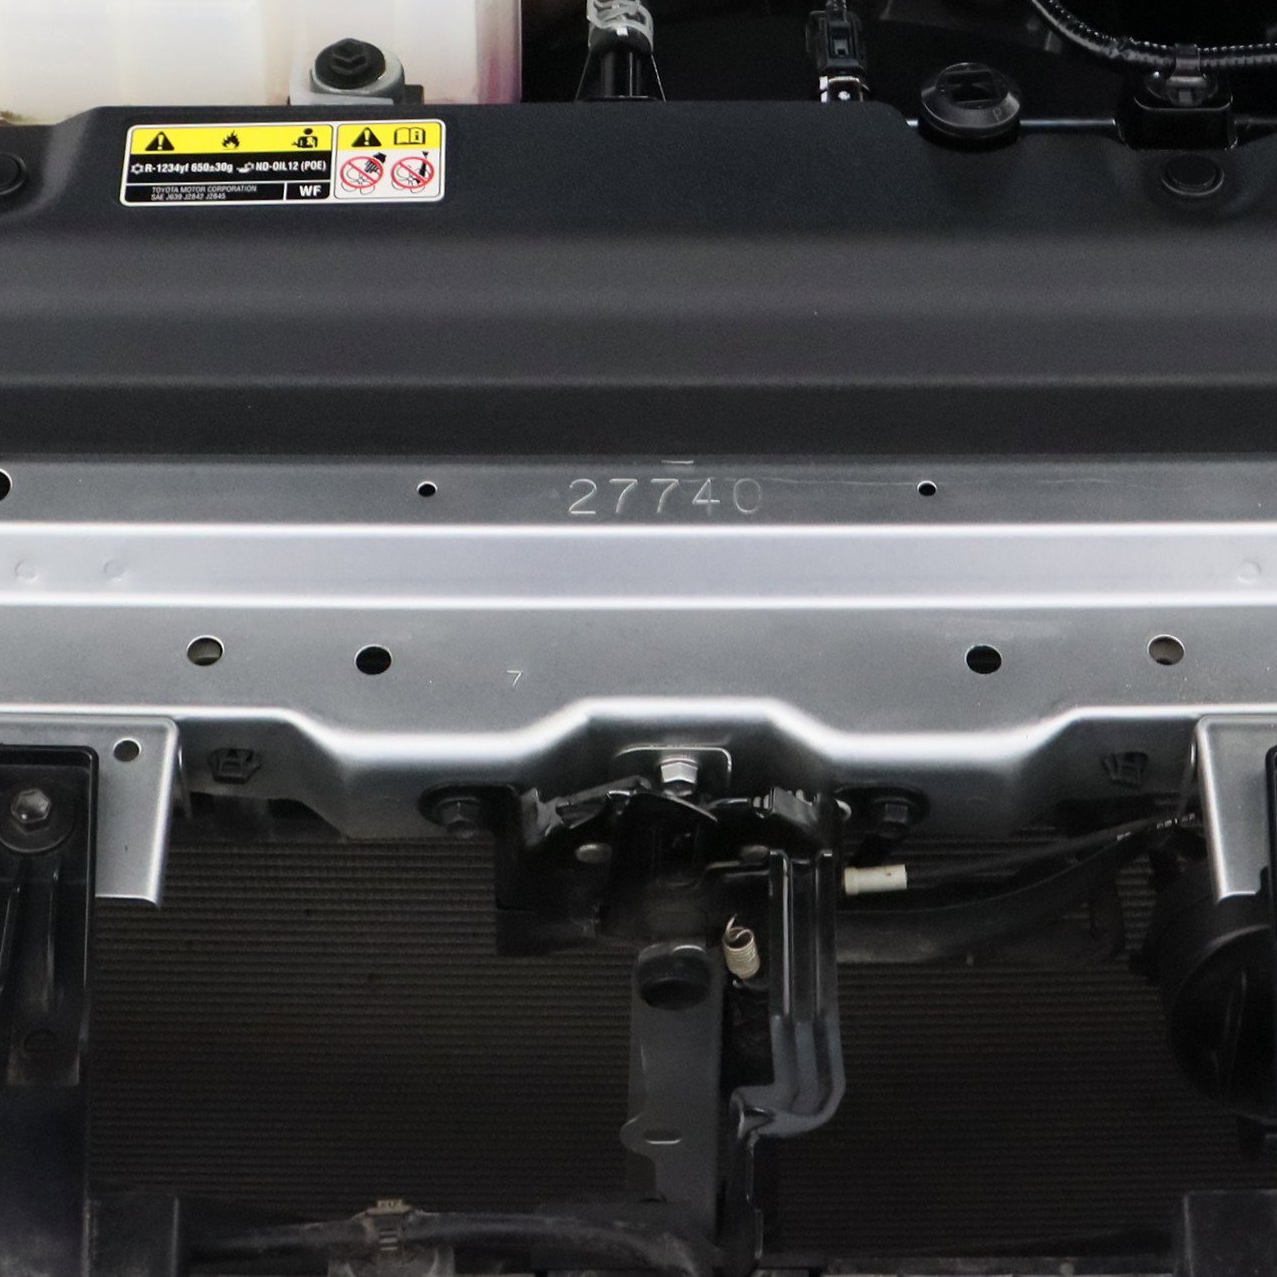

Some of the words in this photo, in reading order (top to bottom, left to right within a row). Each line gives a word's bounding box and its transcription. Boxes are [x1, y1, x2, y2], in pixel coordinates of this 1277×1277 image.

[145, 163, 190, 174] R-1234yf
[191, 162, 234, 174] 650±30g
[300, 160, 327, 172] (POE)
[180, 185, 206, 193] MOTOR
[207, 185, 258, 193] CORPORATION
[299, 185, 322, 198] WF
[567, 476, 764, 515] 27740
